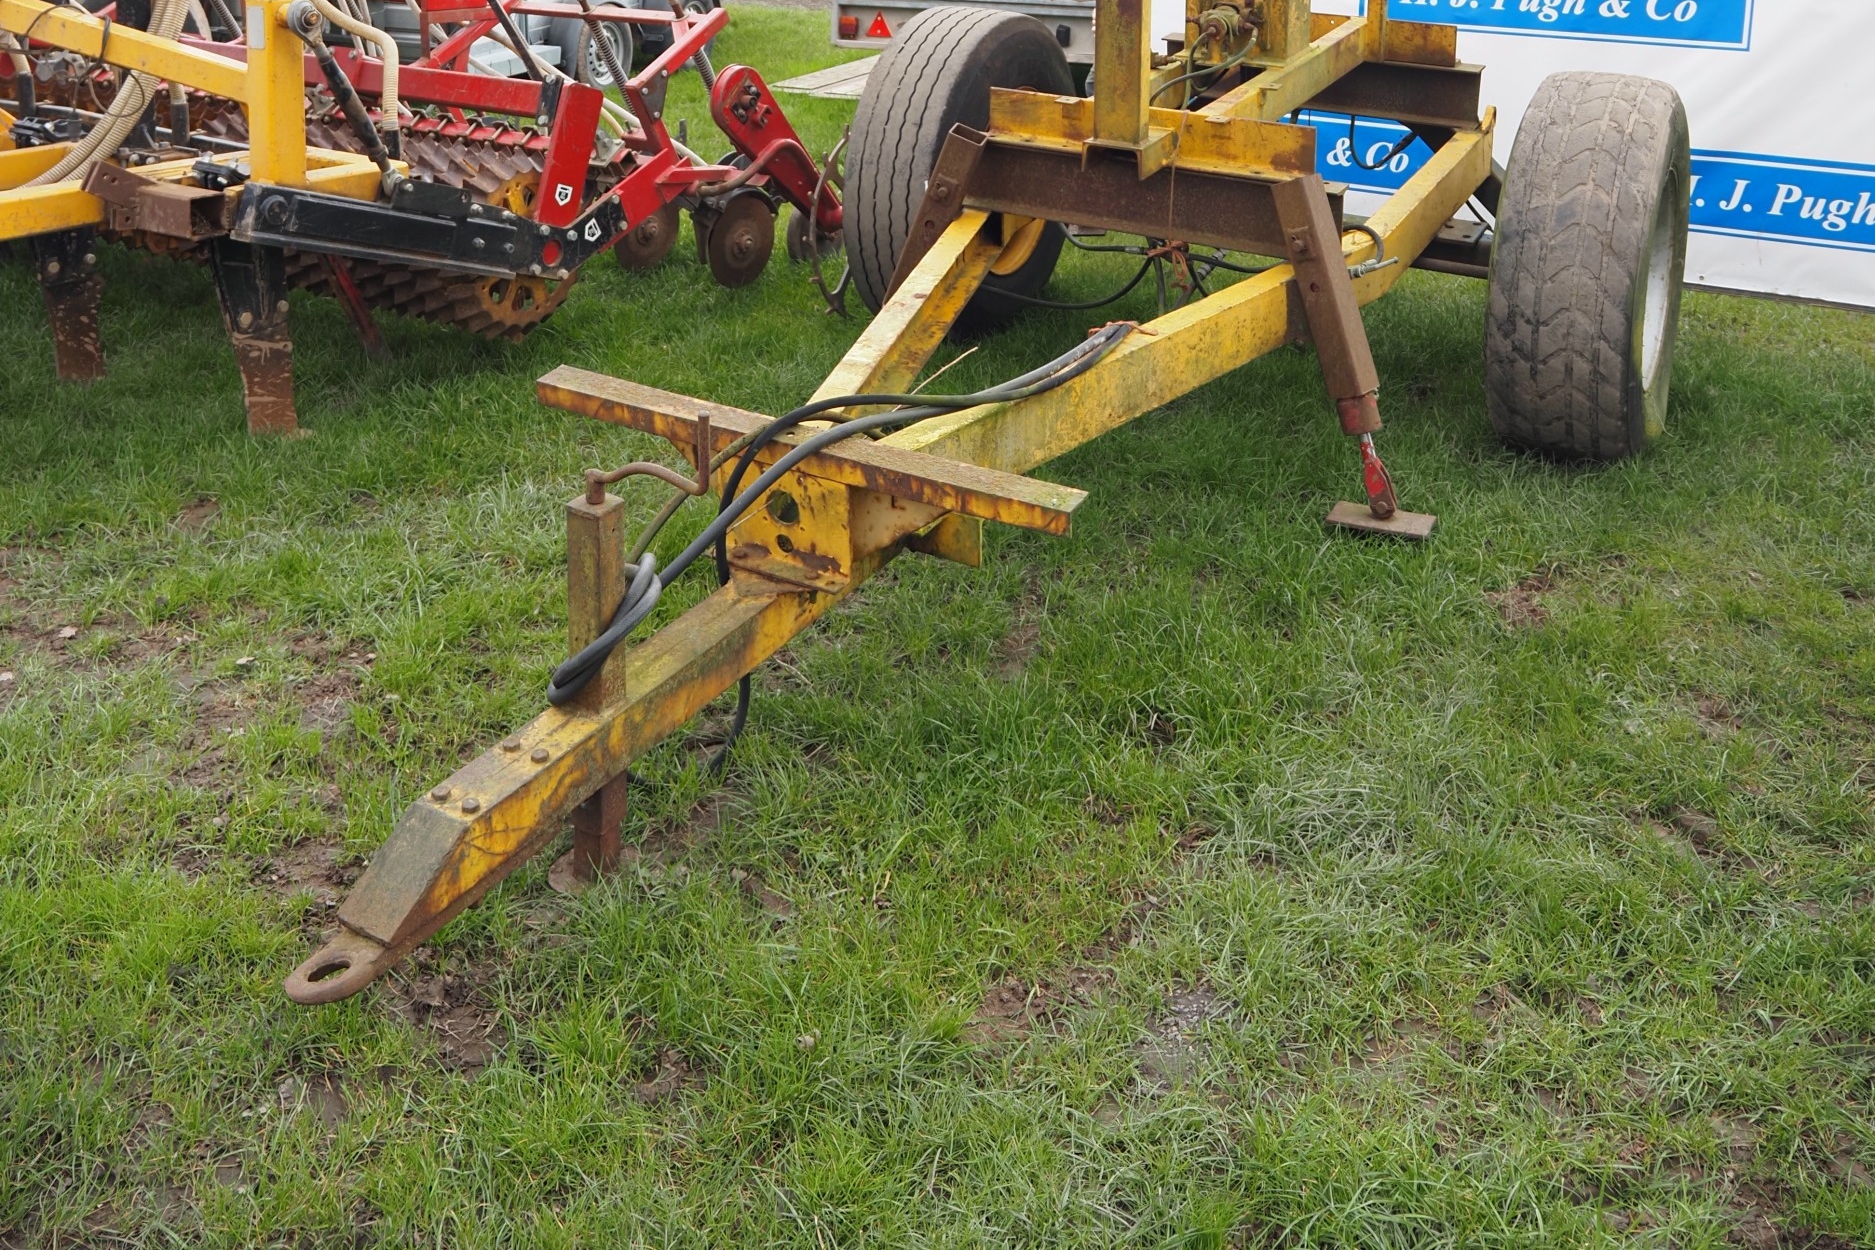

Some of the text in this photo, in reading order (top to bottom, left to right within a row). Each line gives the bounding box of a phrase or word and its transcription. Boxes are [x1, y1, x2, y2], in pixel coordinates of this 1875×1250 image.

[1326, 137, 1409, 173] & Co
[1719, 179, 1753, 212] J.
[1766, 183, 1875, 232] Pugh
